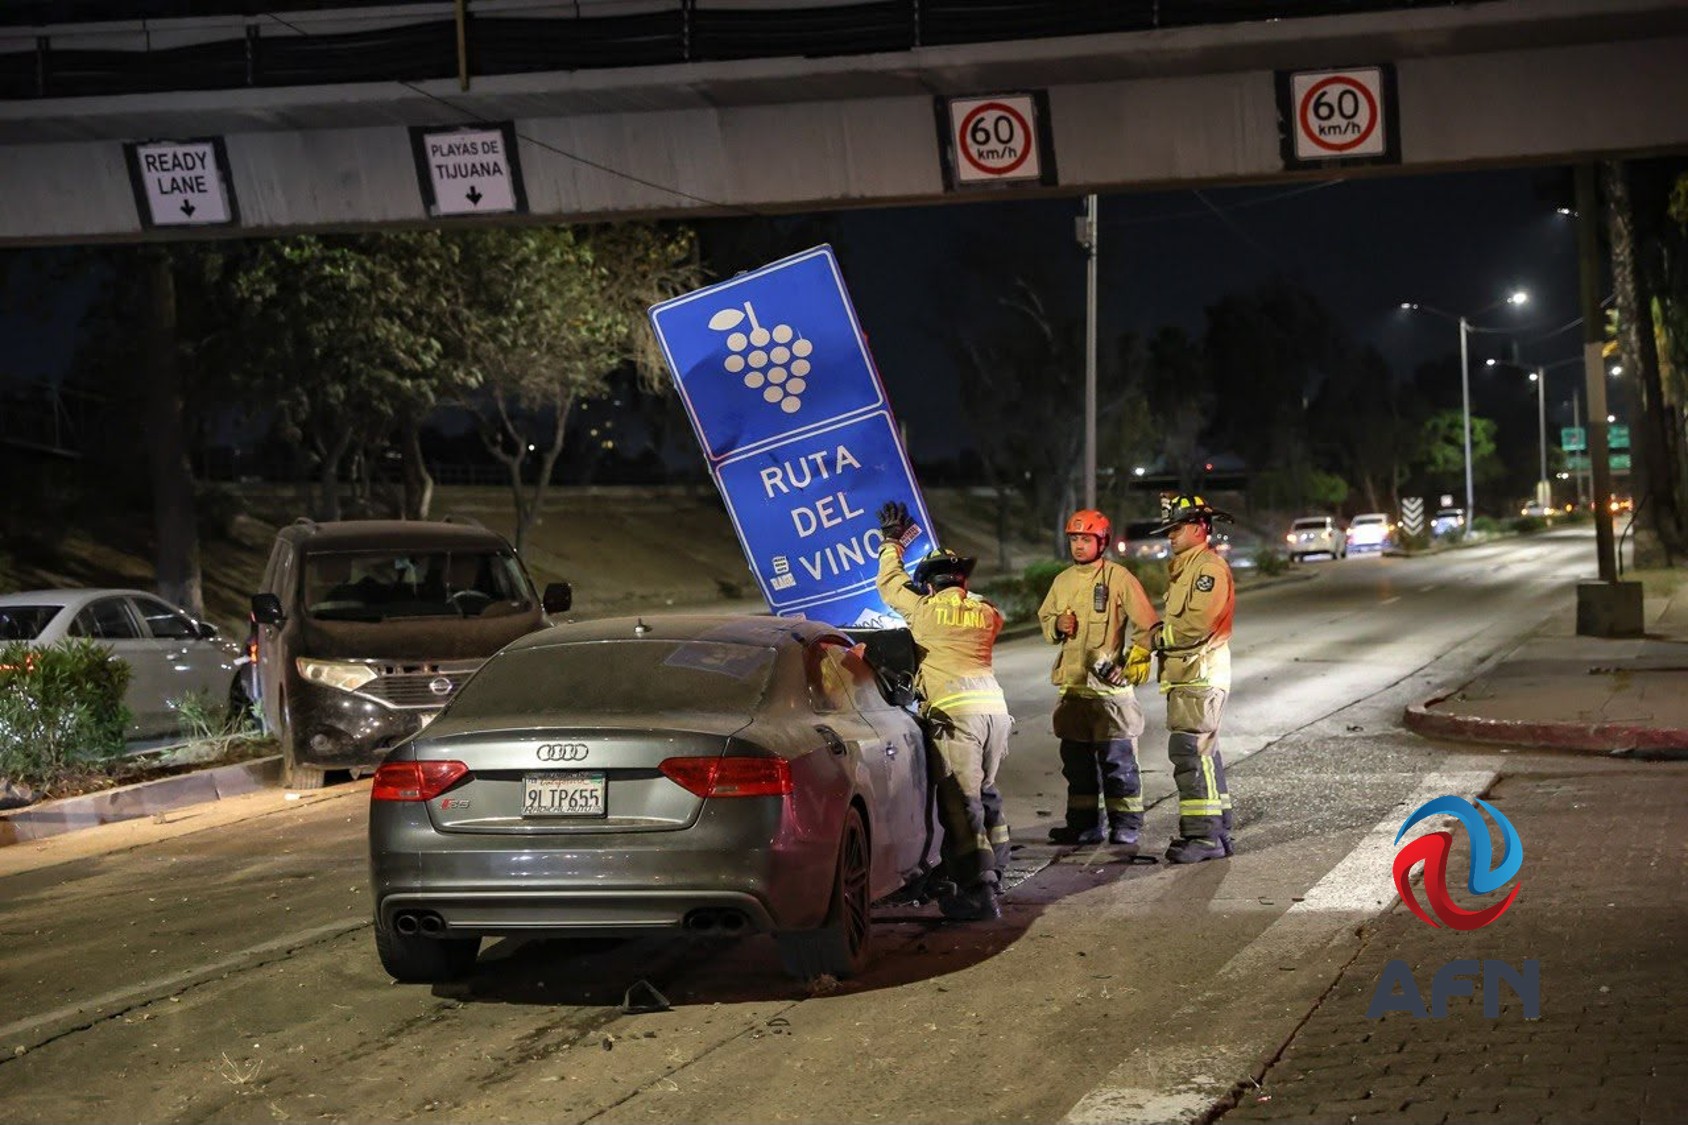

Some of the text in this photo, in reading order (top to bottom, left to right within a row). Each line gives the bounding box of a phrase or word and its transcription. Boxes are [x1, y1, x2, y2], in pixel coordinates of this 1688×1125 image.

[1312, 89, 1360, 121] 60
[970, 115, 1015, 146] 60
[1317, 120, 1362, 137] km/h
[431, 140, 500, 158] PLAYAS DE
[976, 146, 1018, 161] km/h
[144, 150, 207, 173] READY
[435, 161, 504, 180] TIJUANA
[157, 175, 208, 195] LANE
[760, 445, 861, 498] RUTA
[791, 491, 865, 538] DEL
[799, 528, 884, 581] VINO
[935, 607, 986, 629] TIJUANA
[528, 789, 600, 808] 9LTP655
